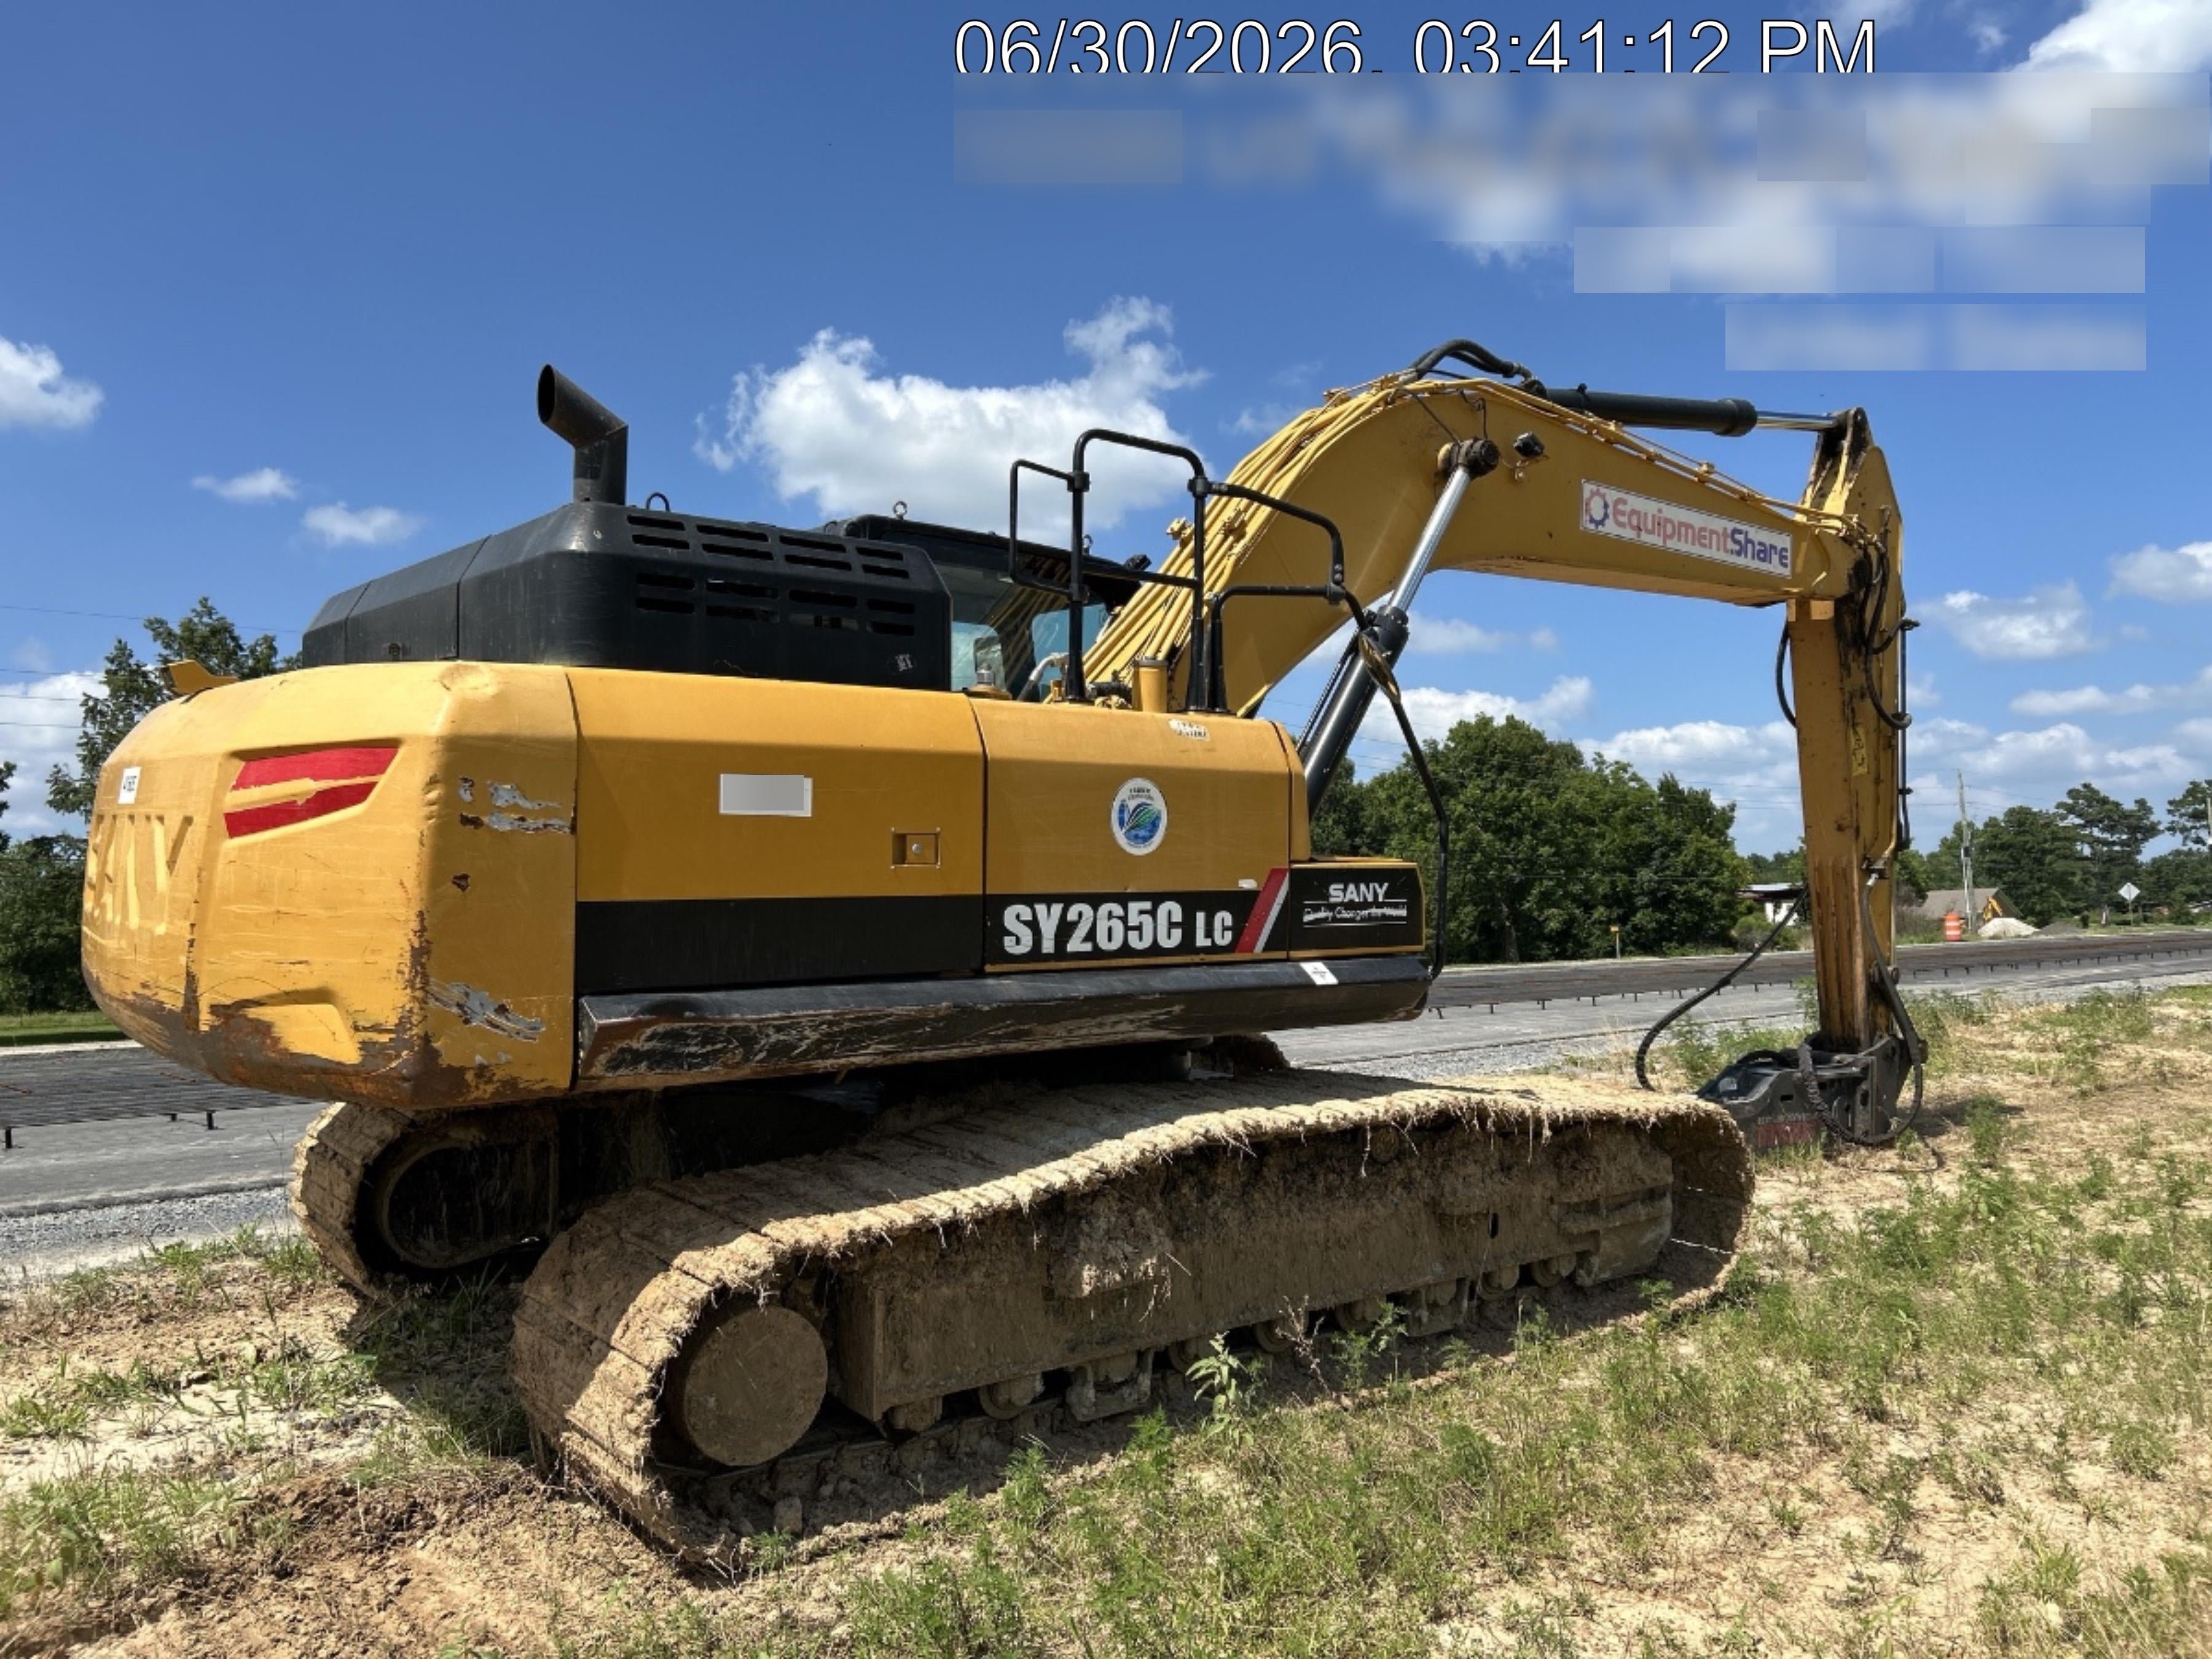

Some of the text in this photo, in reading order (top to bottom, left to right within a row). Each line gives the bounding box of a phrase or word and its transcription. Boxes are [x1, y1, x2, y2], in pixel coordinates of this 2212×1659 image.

[1611, 497, 1789, 568] EquipmentShare
[1328, 882, 1389, 903] SANY
[1003, 901, 1233, 955] SY265C LC
